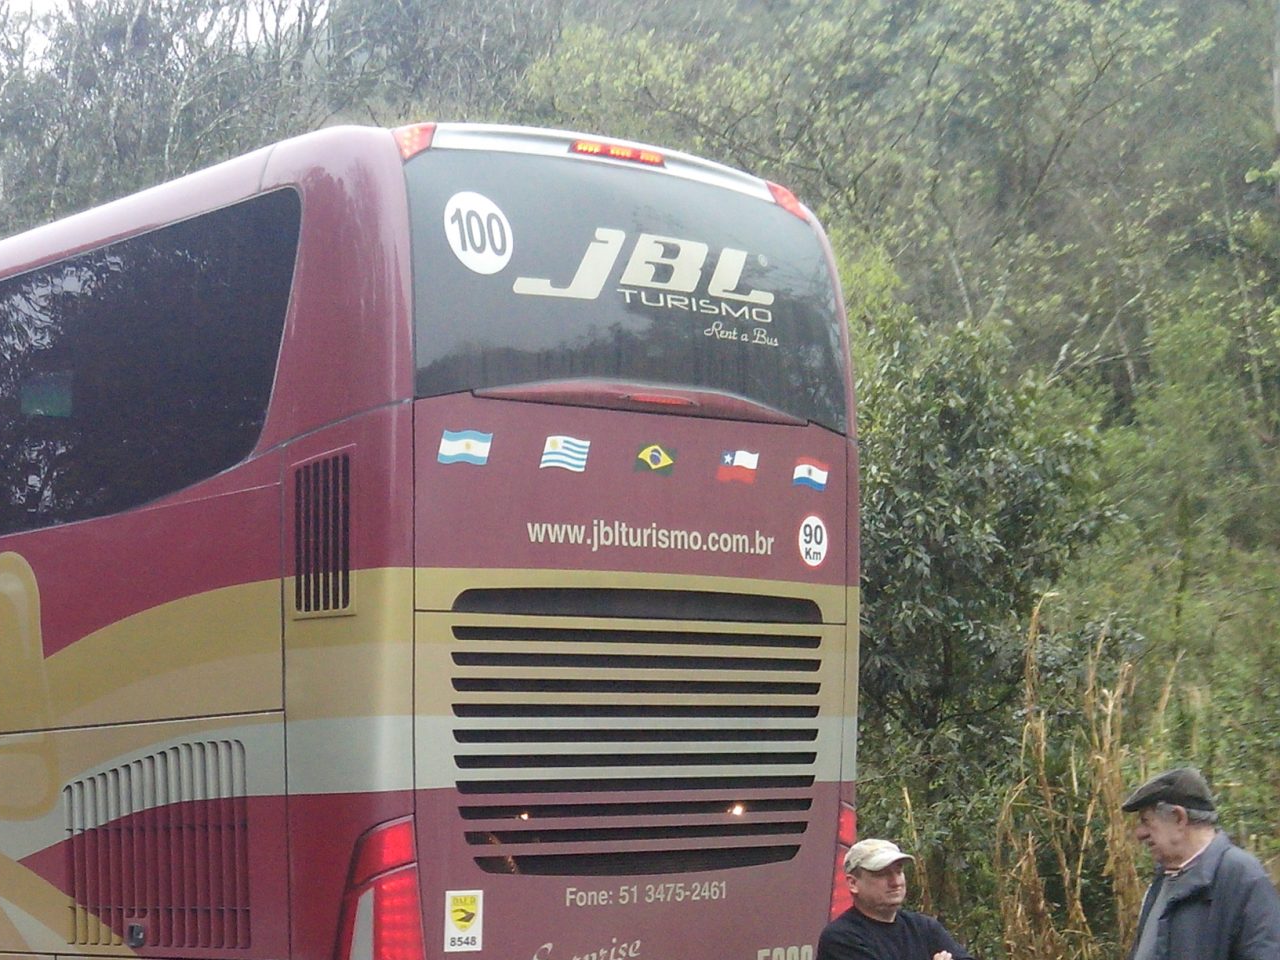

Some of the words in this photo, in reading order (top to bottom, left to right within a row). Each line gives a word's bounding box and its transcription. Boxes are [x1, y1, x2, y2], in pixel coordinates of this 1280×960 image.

[450, 205, 507, 257] 100
[616, 288, 773, 323] TURISMO
[703, 321, 737, 341] Rent
[753, 328, 779, 347] Bus
[527, 520, 775, 556] www.jblturismo.com.br
[803, 523, 824, 546] 90
[804, 546, 822, 561] Km
[565, 886, 613, 907] Fone:
[618, 885, 640, 904] 51
[644, 880, 727, 904] 3475-2461
[450, 936, 477, 947] 8548
